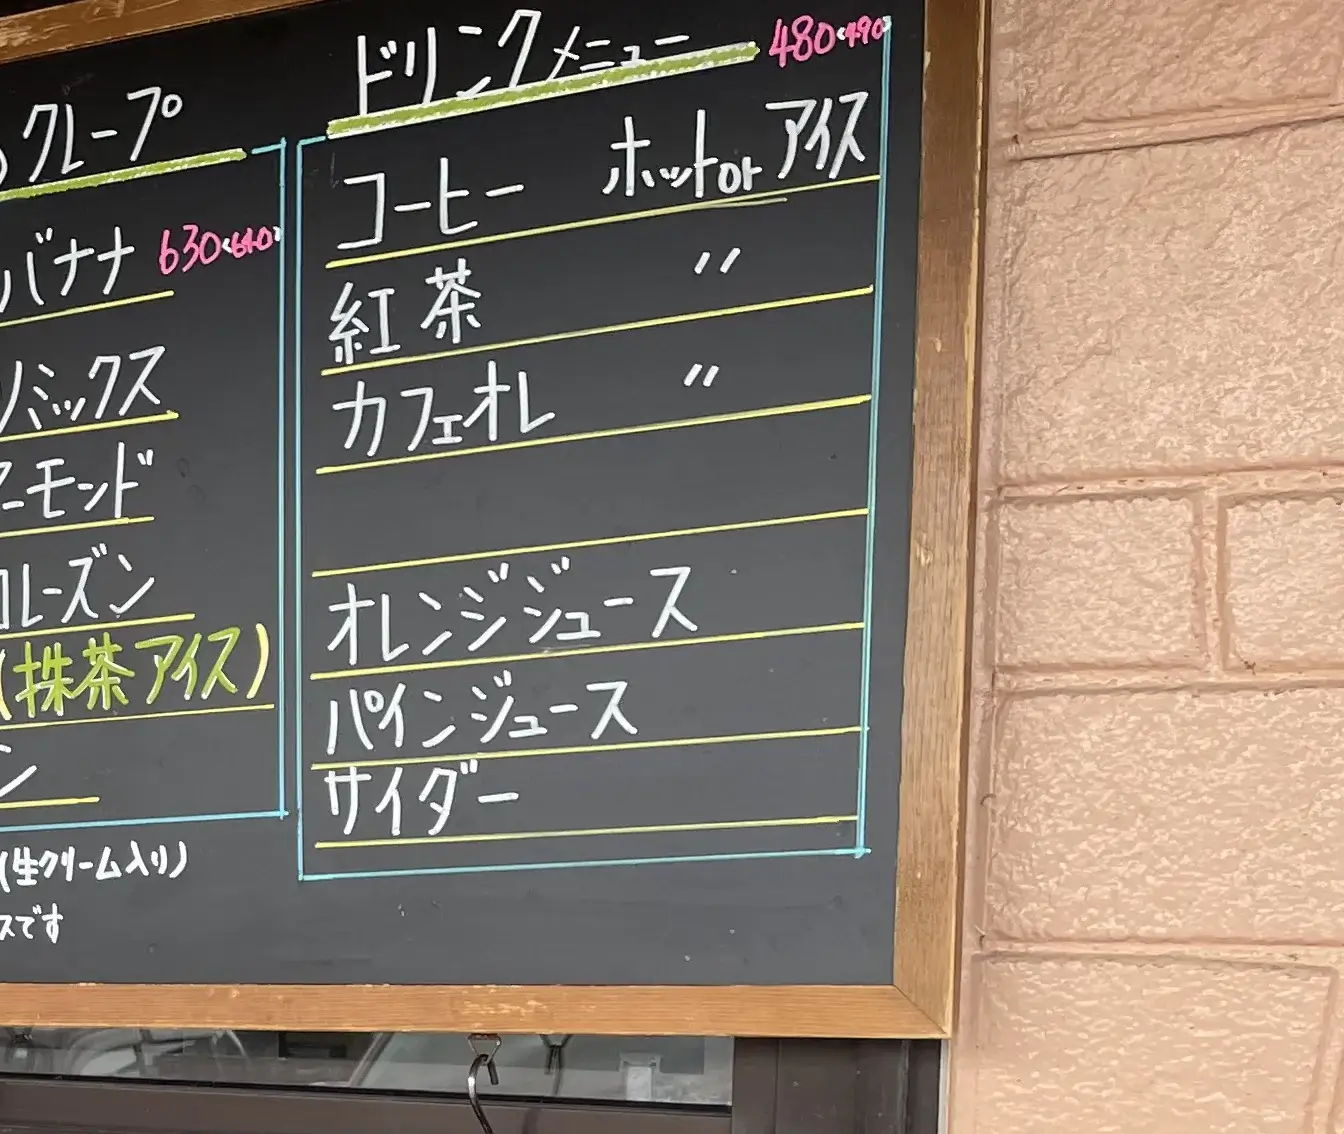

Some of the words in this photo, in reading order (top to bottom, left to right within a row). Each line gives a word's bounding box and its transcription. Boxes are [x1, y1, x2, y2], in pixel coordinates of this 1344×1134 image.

[358, 10, 690, 116] ドリンクメニュー
[337, 156, 524, 249] コーヒー
[329, 258, 482, 365] 紅茶
[333, 361, 555, 456] カフェオレ
[328, 556, 697, 666] オレンジジュース
[328, 670, 638, 755] パインジュース
[324, 760, 520, 836] サイダー
